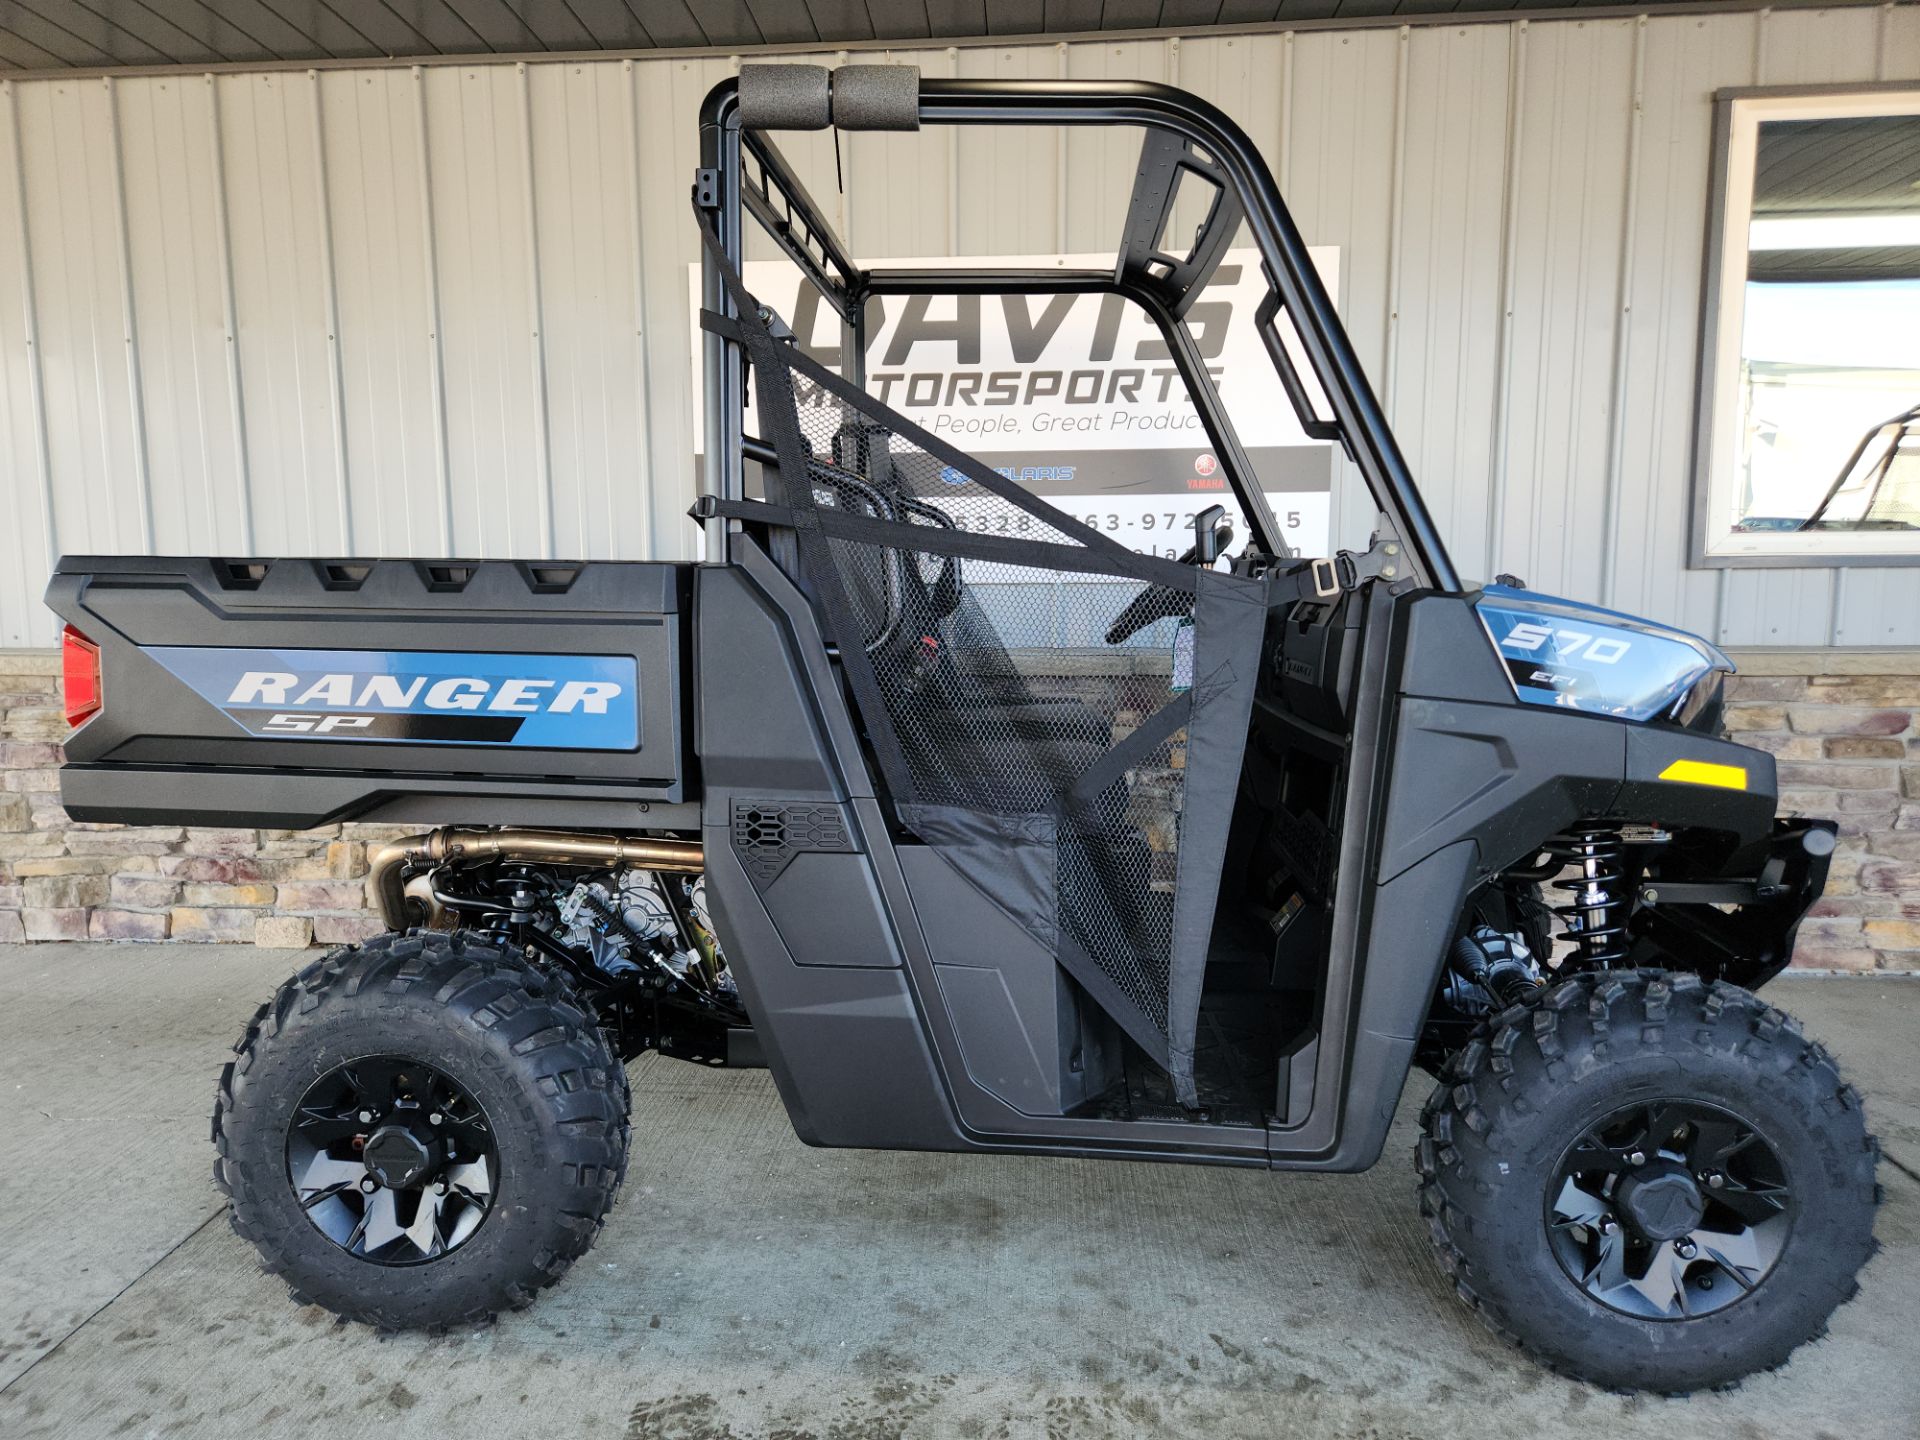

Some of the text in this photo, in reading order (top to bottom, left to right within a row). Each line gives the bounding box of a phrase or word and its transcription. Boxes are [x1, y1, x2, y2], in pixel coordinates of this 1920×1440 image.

[791, 264, 1243, 366] DAVIS
[790, 366, 1225, 409] TORSPORT
[934, 413, 1021, 438] People,
[1032, 412, 1102, 432] Great
[1110, 410, 1205, 431] Produc
[993, 466, 1074, 481] OLARIS
[1187, 479, 1225, 489] YAMAHA
[938, 515, 1031, 533] 5328
[1501, 623, 1632, 665] 570
[1529, 671, 1578, 686] EFI
[227, 671, 622, 714] RANGER
[262, 714, 375, 733] SP
